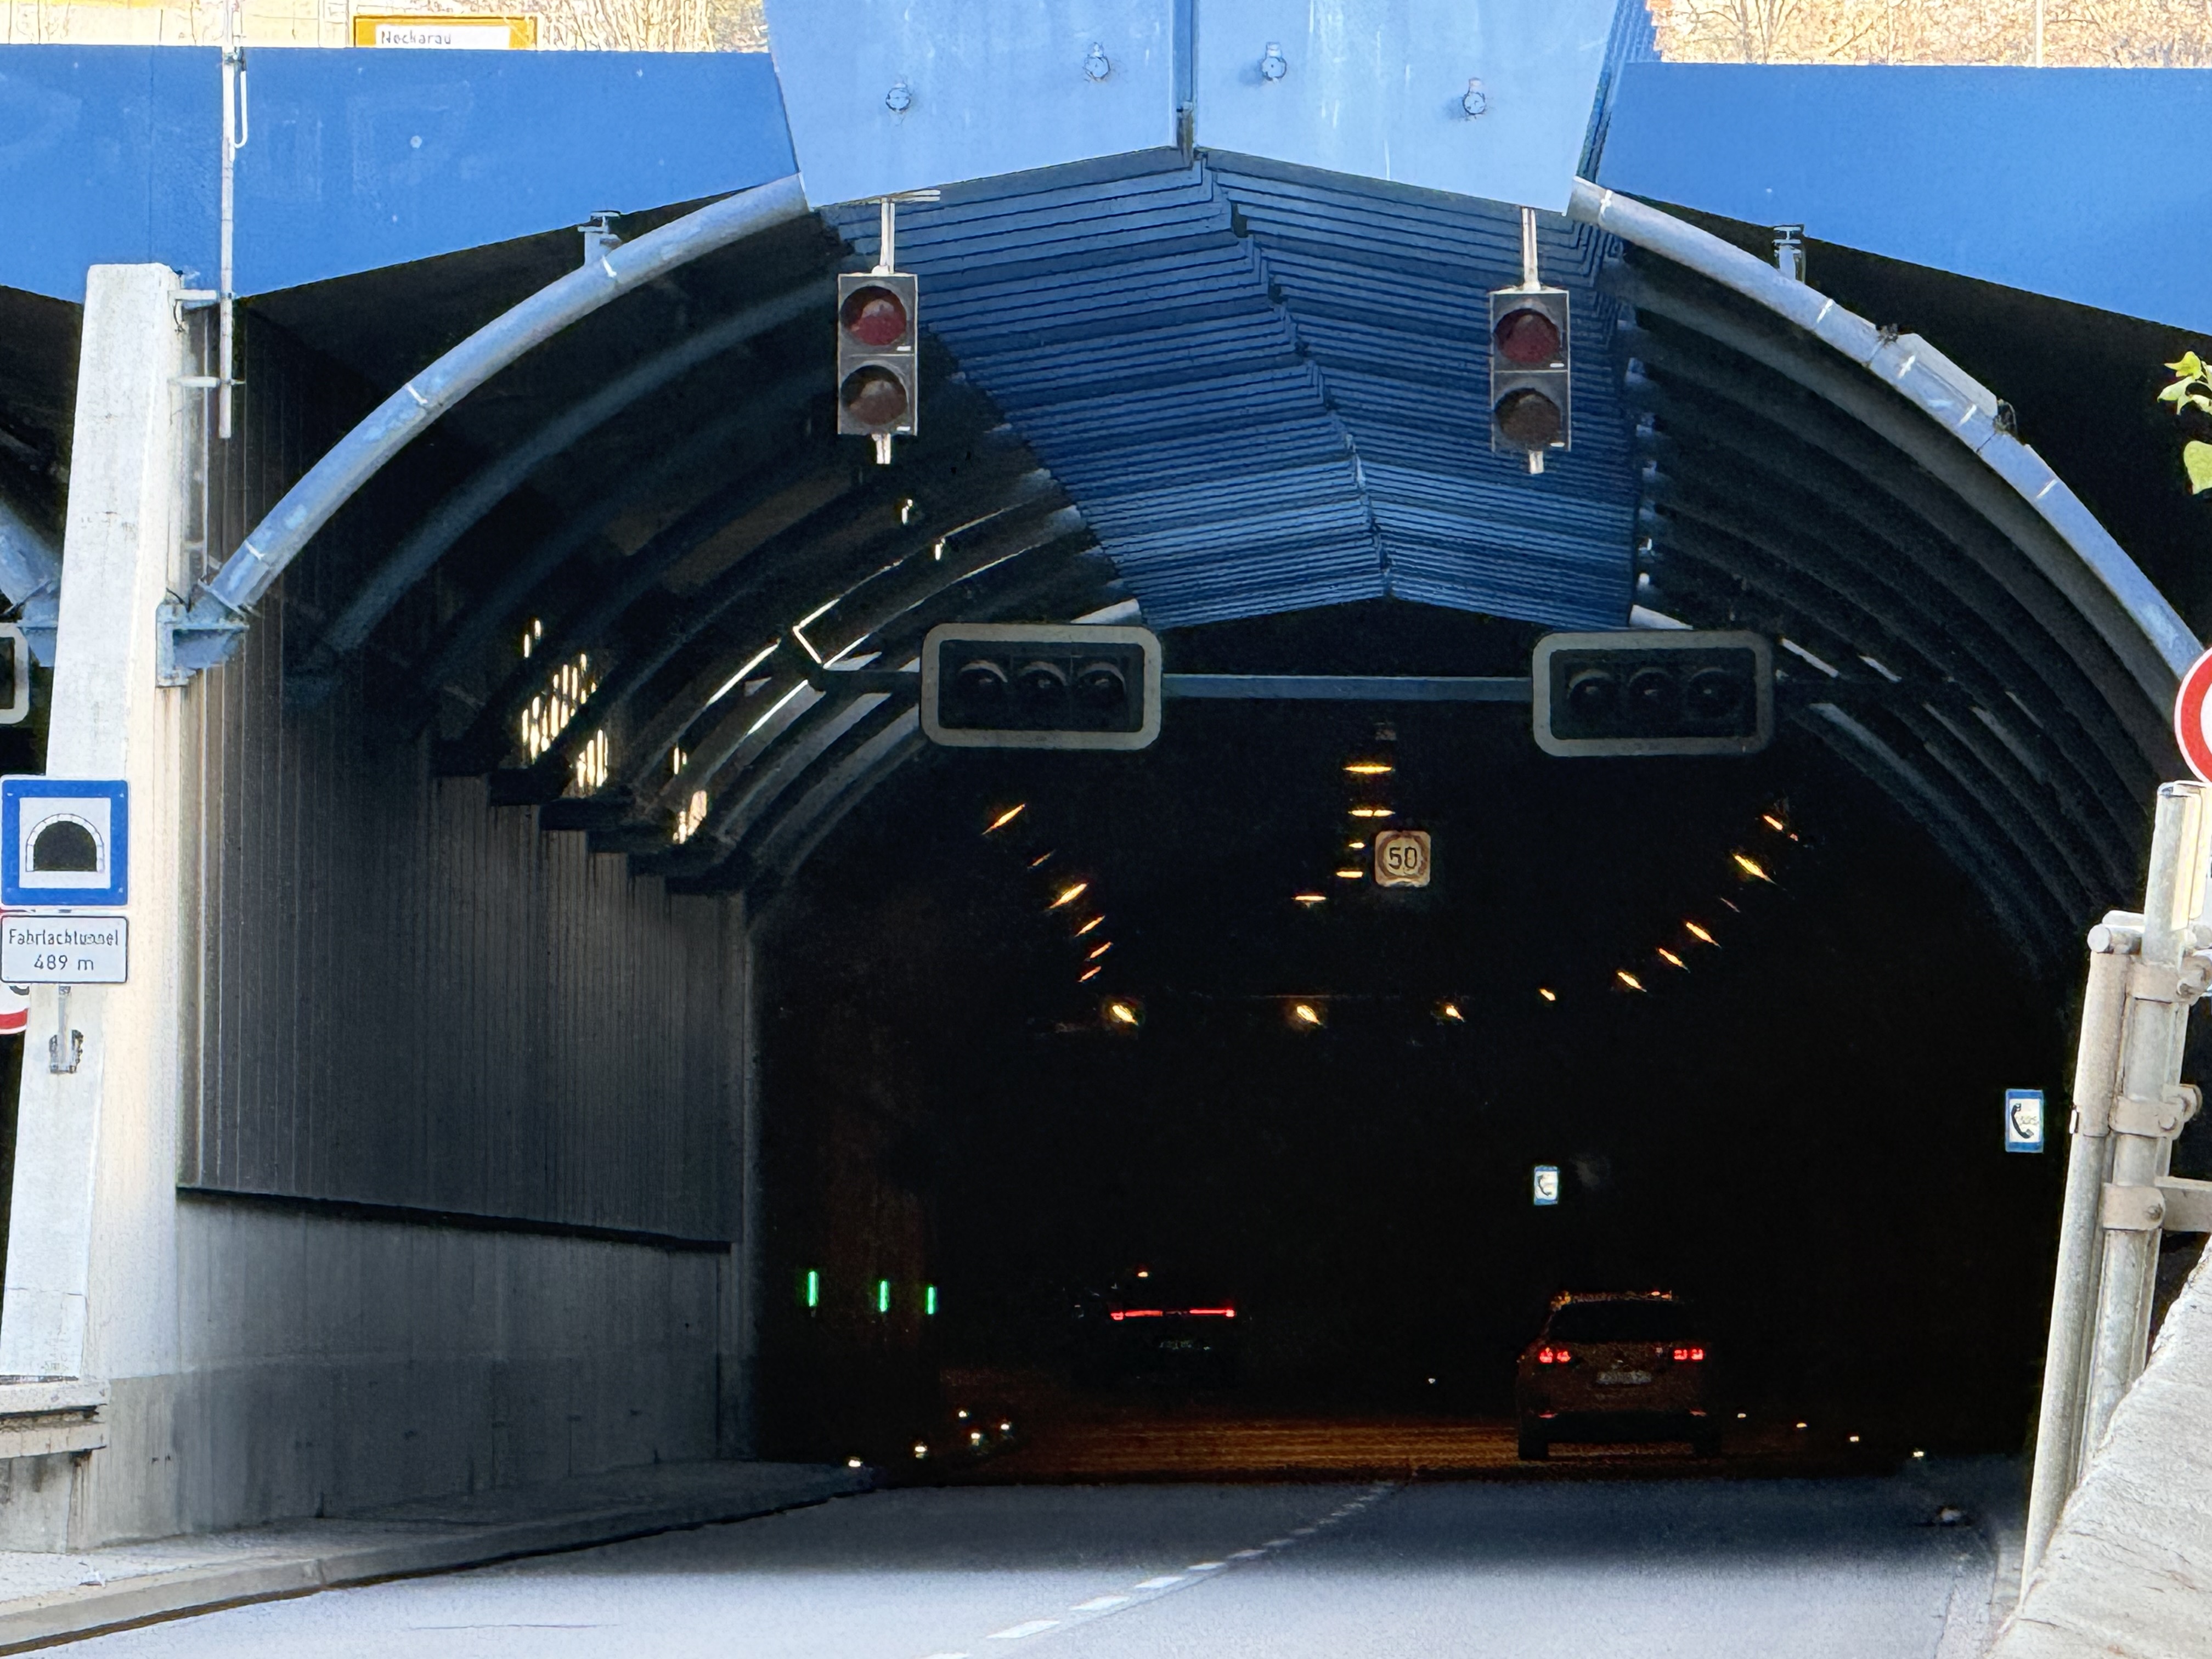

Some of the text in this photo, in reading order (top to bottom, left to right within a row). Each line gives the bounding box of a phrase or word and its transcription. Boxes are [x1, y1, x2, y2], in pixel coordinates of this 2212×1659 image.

[1389, 847, 1418, 870] 50
[9, 929, 119, 945] Fahrlachtunnel
[33, 954, 94, 970] 489 m
